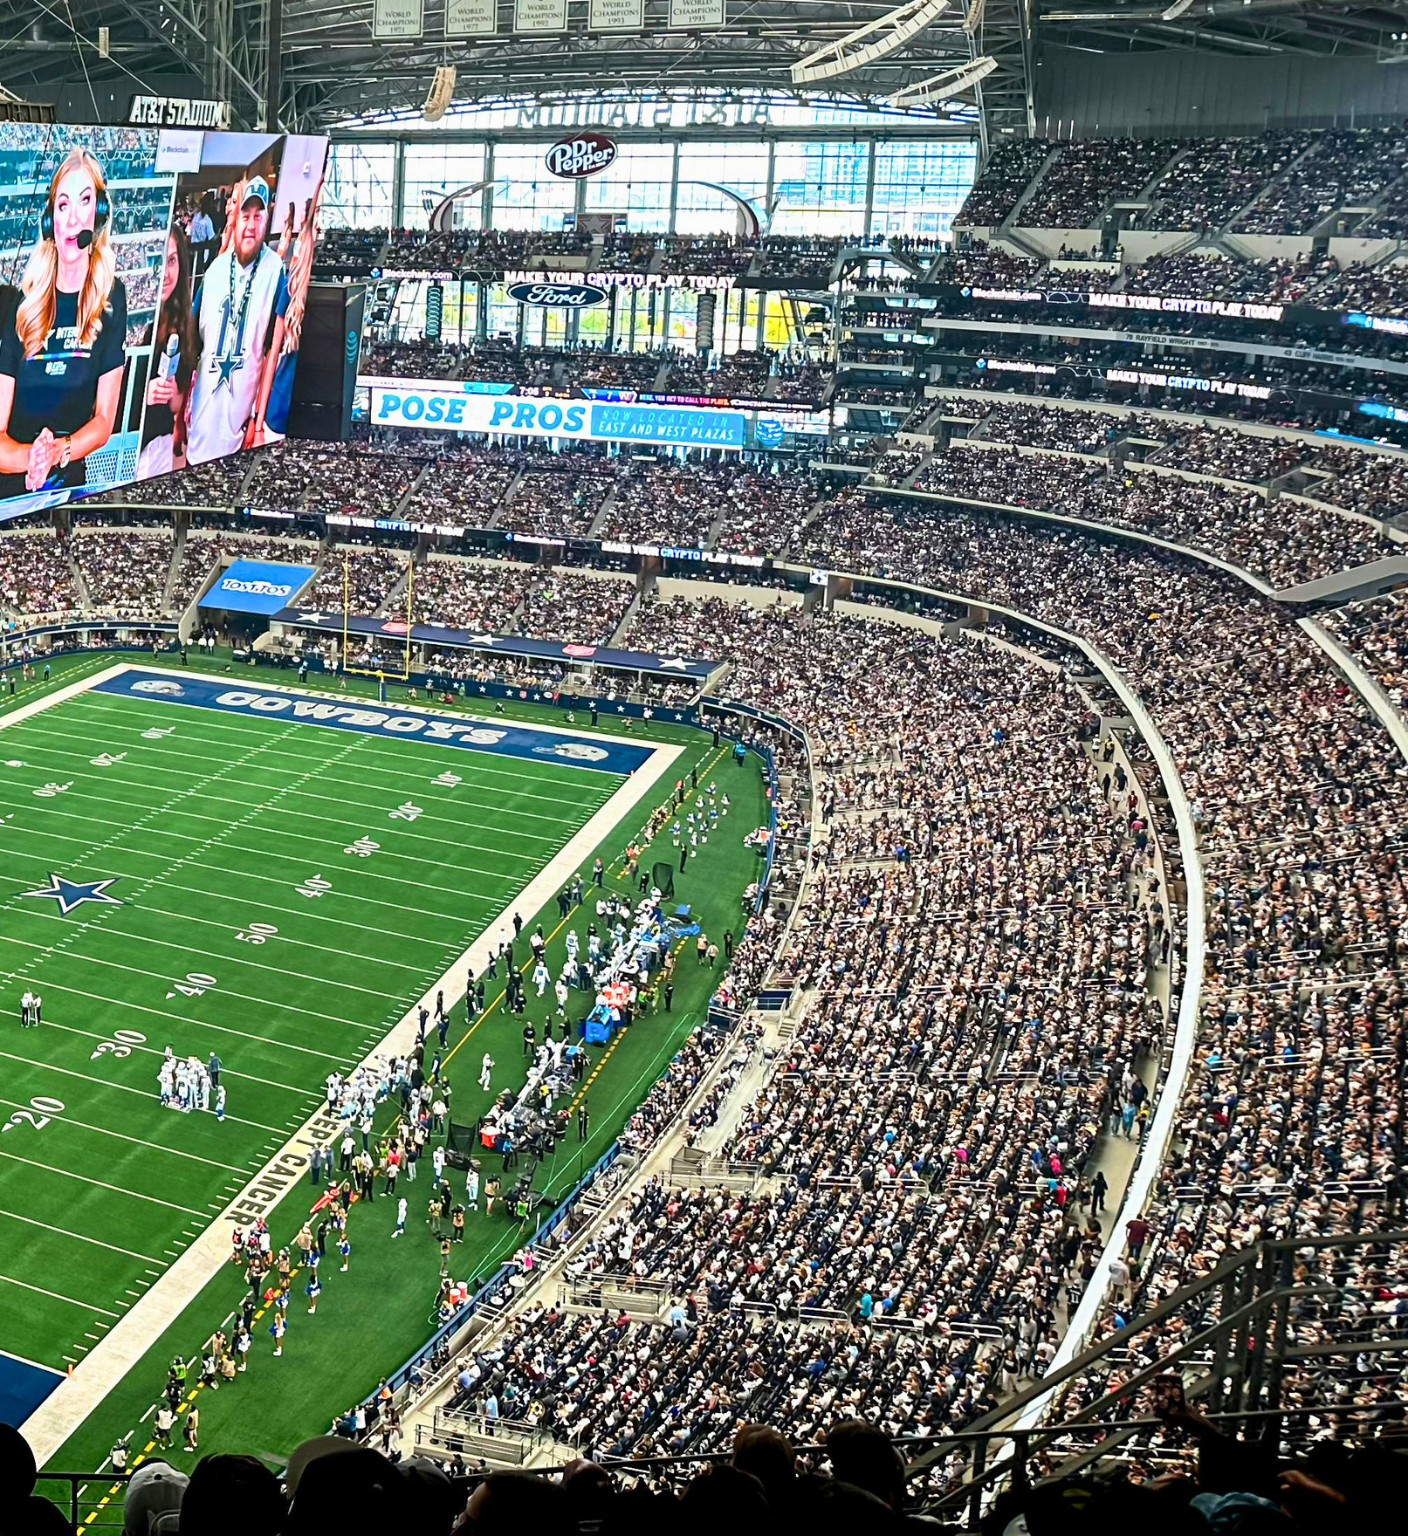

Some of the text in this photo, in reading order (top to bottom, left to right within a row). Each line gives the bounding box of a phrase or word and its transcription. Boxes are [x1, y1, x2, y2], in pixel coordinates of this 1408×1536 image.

[593, 9, 639, 18] CHAMPIONS
[602, 1, 631, 9] WORLD
[673, 7, 721, 16] CHAMPIONS
[377, 18, 418, 27] CHAMPIONS
[449, 15, 493, 24] CHAMPIONS
[518, 11, 563, 20] CHAMPIONS
[532, 20, 549, 28] 1992
[129, 95, 224, 127] AT&T STADIUM
[572, 140, 598, 158] Dr
[549, 143, 613, 174] Pepper
[382, 268, 453, 281] Blockchain.com
[504, 271, 736, 289] MAKE YOUR CRYPTO PLAY TODAY
[527, 285, 587, 305] Ford
[972, 287, 1042, 301] Blockchain.com
[1089, 293, 1284, 321] MAKE YOUR CRYPTO PLAY TODAY
[1135, 334, 1167, 344] RAYFIELD
[1169, 337, 1196, 346] WRIGHT
[1107, 369, 1271, 399] MAKE YOUR CRYPTO PLAY TODAY
[378, 394, 467, 424] POSE
[489, 401, 586, 432] PROS
[602, 409, 728, 427] NOW LOCATED IN
[599, 421, 734, 441] EAST AND WEST PLAZAS
[375, 520, 411, 532] CRYPTO
[411, 524, 435, 533] PLAY
[660, 547, 700, 561] CRYPTO
[701, 551, 730, 564] PLAY
[215, 691, 508, 745] COWBOYS
[141, 726, 172, 739] 10
[89, 752, 122, 766] 20
[430, 772, 462, 788] 10
[32, 782, 68, 797] 30
[388, 805, 423, 821] 20
[343, 840, 380, 857] 30
[295, 878, 332, 898] 40
[234, 922, 279, 945] 50
[174, 972, 217, 997] 40
[96, 1029, 147, 1058] 30
[10, 1096, 65, 1130] 20
[224, 1153, 308, 1227] CANCER
